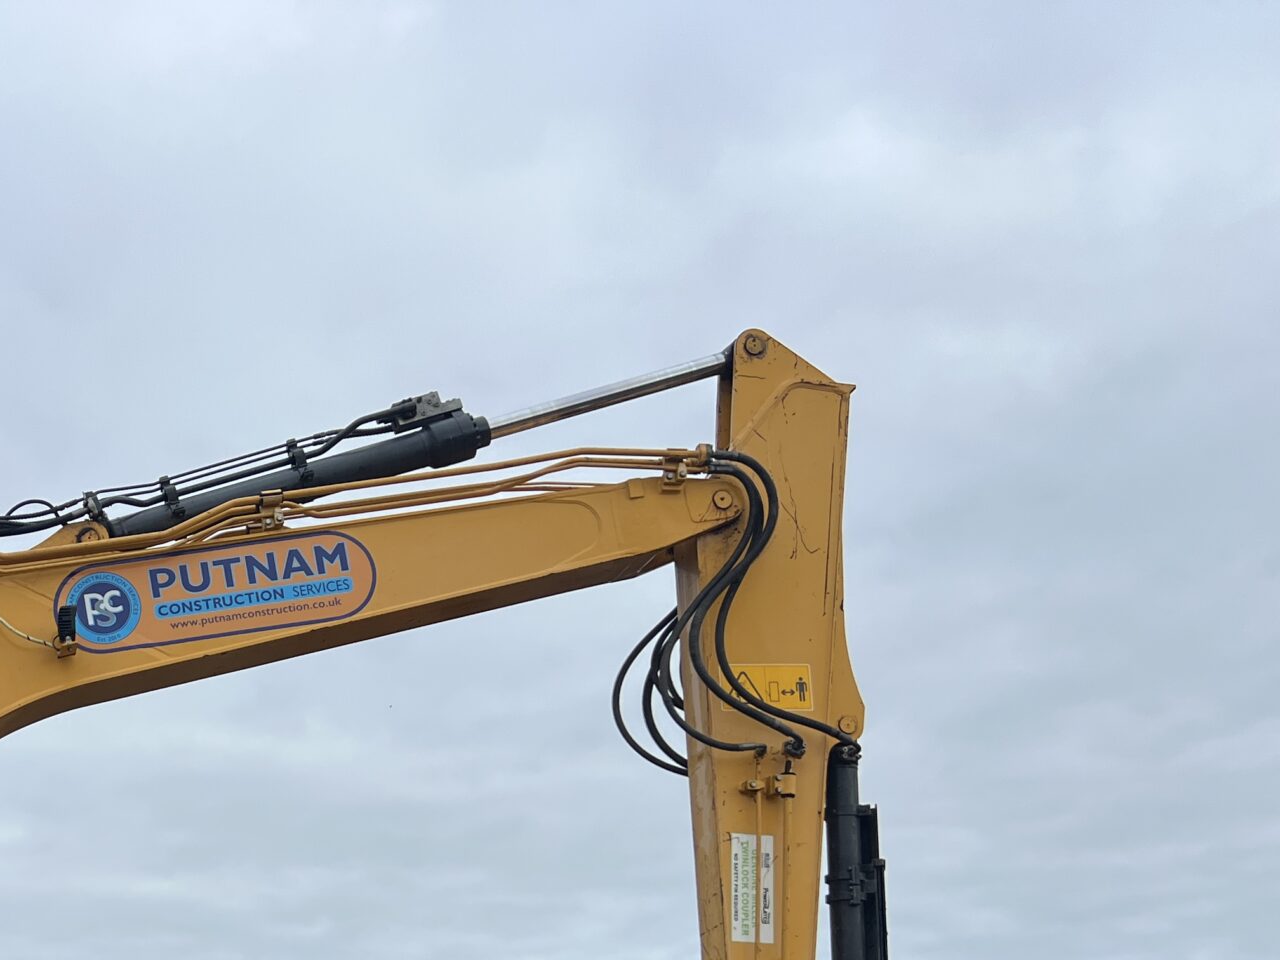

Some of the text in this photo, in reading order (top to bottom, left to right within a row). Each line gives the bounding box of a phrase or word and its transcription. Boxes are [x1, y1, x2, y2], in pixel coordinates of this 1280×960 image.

[148, 542, 350, 599] PUTNAM
[158, 579, 351, 617] CONSTRUCTION SERVICES
[170, 597, 342, 629] www.putnamconstruction.co.uk
[733, 853, 738, 861] NO
[741, 840, 749, 936] TWINLOCK COUPLER
